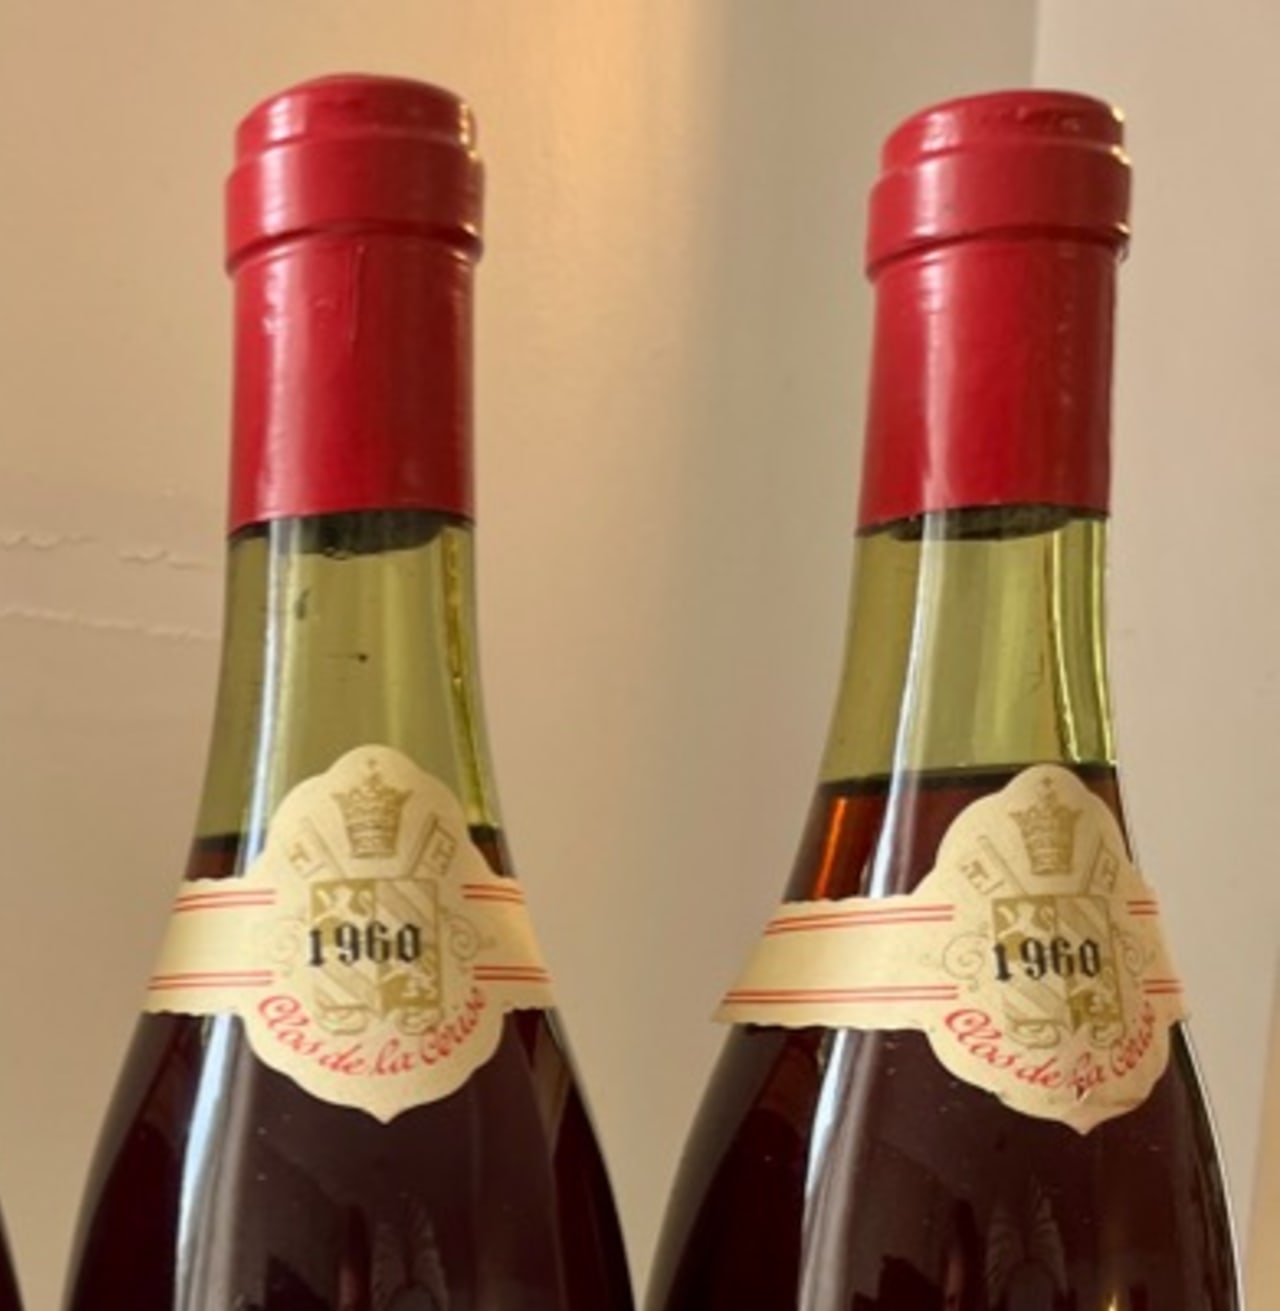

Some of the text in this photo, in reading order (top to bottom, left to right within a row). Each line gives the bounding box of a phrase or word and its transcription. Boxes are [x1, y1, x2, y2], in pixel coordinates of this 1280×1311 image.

[307, 921, 422, 967] 1960
[993, 936, 1101, 982] 1960
[258, 995, 320, 1060] Clos
[321, 1043, 367, 1077] de
[370, 1038, 413, 1077] la
[945, 1009, 1015, 1066] Clos
[1016, 1056, 1063, 1089] de
